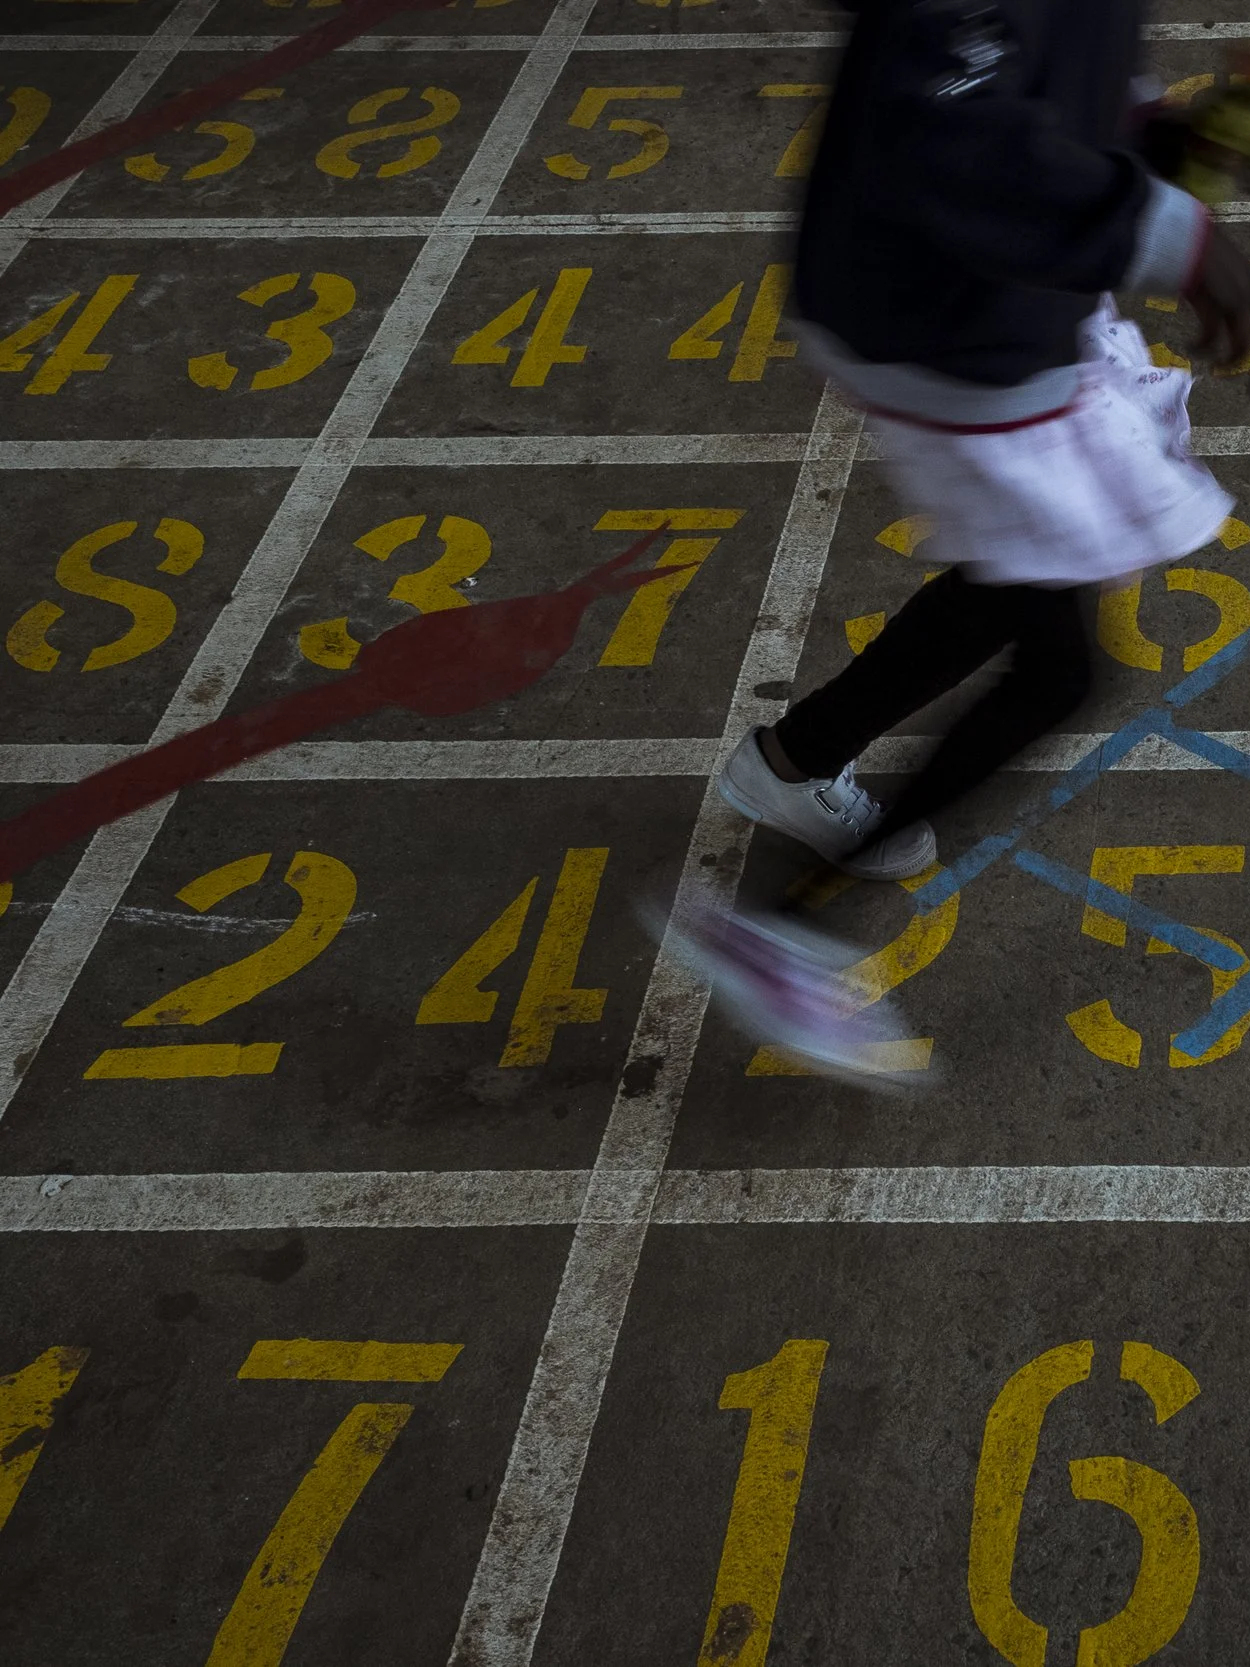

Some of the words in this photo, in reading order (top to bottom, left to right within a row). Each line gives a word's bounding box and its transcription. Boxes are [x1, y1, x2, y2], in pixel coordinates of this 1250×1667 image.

[124, 86, 462, 182] 58
[0, 271, 357, 395] 43
[450, 264, 803, 388] 44
[297, 507, 748, 671] 37
[82, 846, 611, 1080] 24
[697, 1337, 1202, 1667] 16
